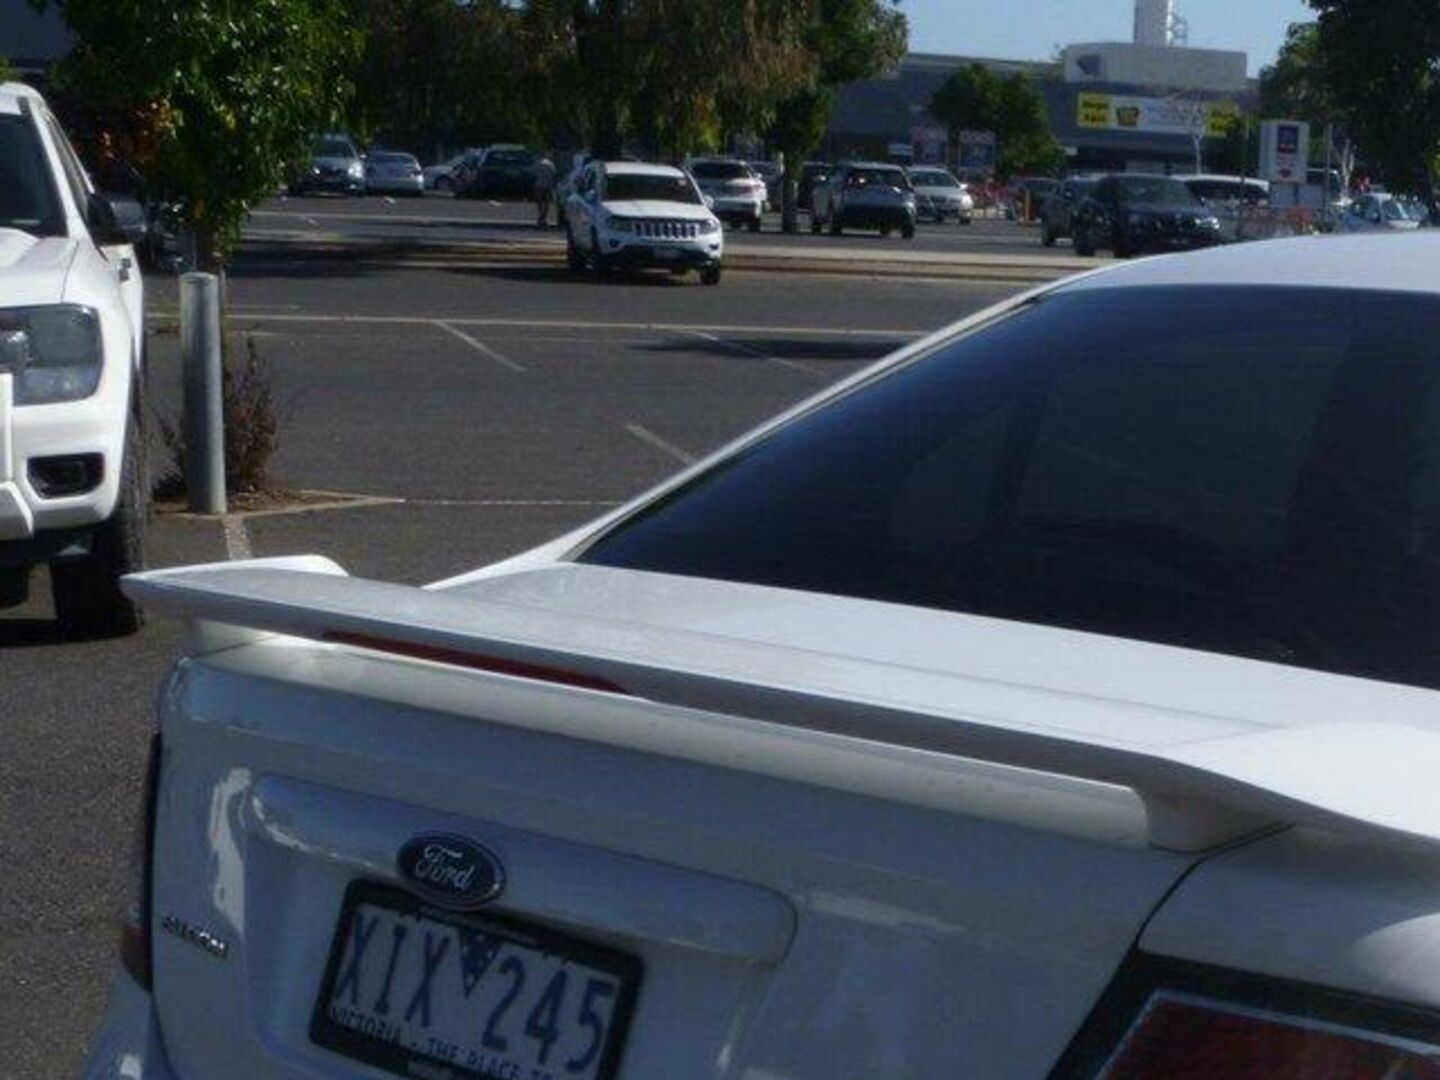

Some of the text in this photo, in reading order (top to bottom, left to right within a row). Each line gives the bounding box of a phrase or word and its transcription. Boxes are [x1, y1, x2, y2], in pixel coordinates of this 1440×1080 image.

[415, 844, 475, 889] Ford
[335, 911, 616, 1074] XIX 245
[426, 1036, 463, 1064] THE
